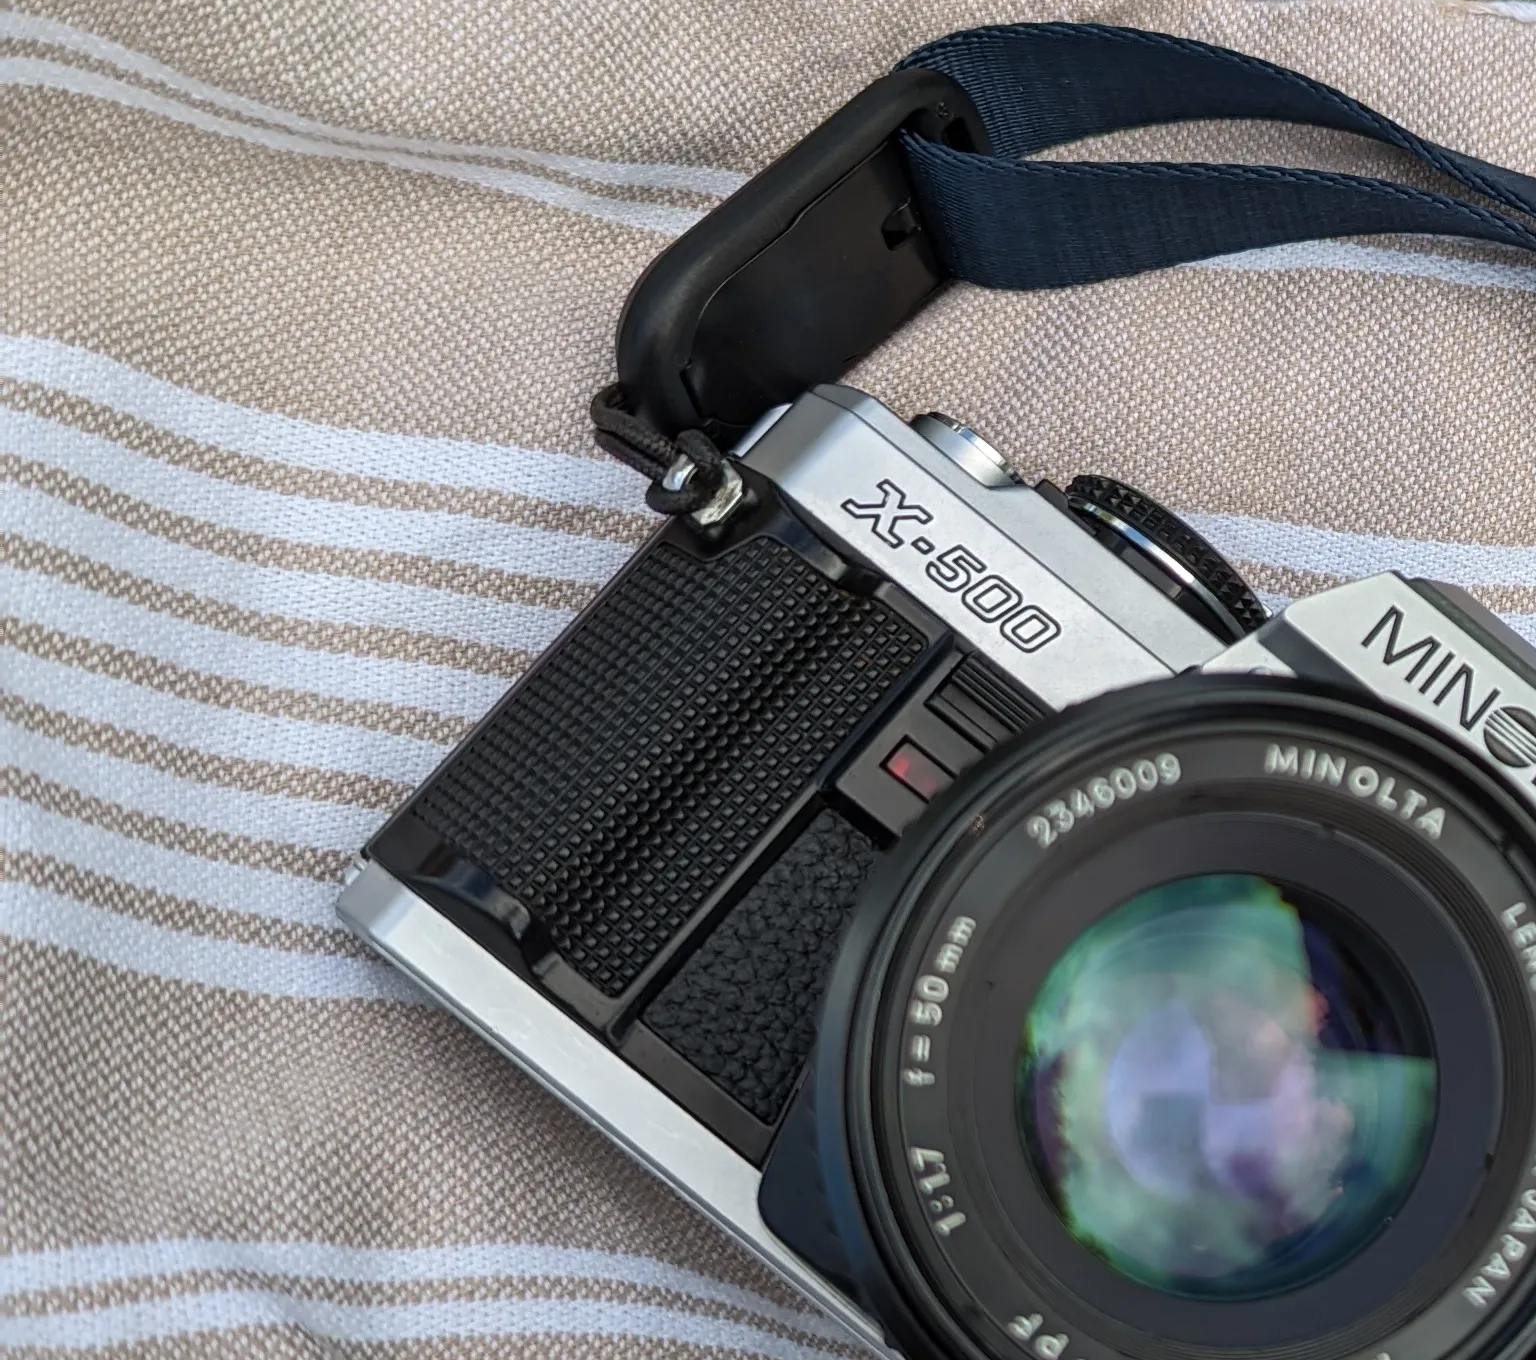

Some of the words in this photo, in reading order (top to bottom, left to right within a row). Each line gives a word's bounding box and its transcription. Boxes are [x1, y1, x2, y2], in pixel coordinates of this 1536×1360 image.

[841, 479, 1061, 653] X-500
[1027, 753, 1181, 848] 2346009
[1264, 744, 1447, 840] MINOLTA
